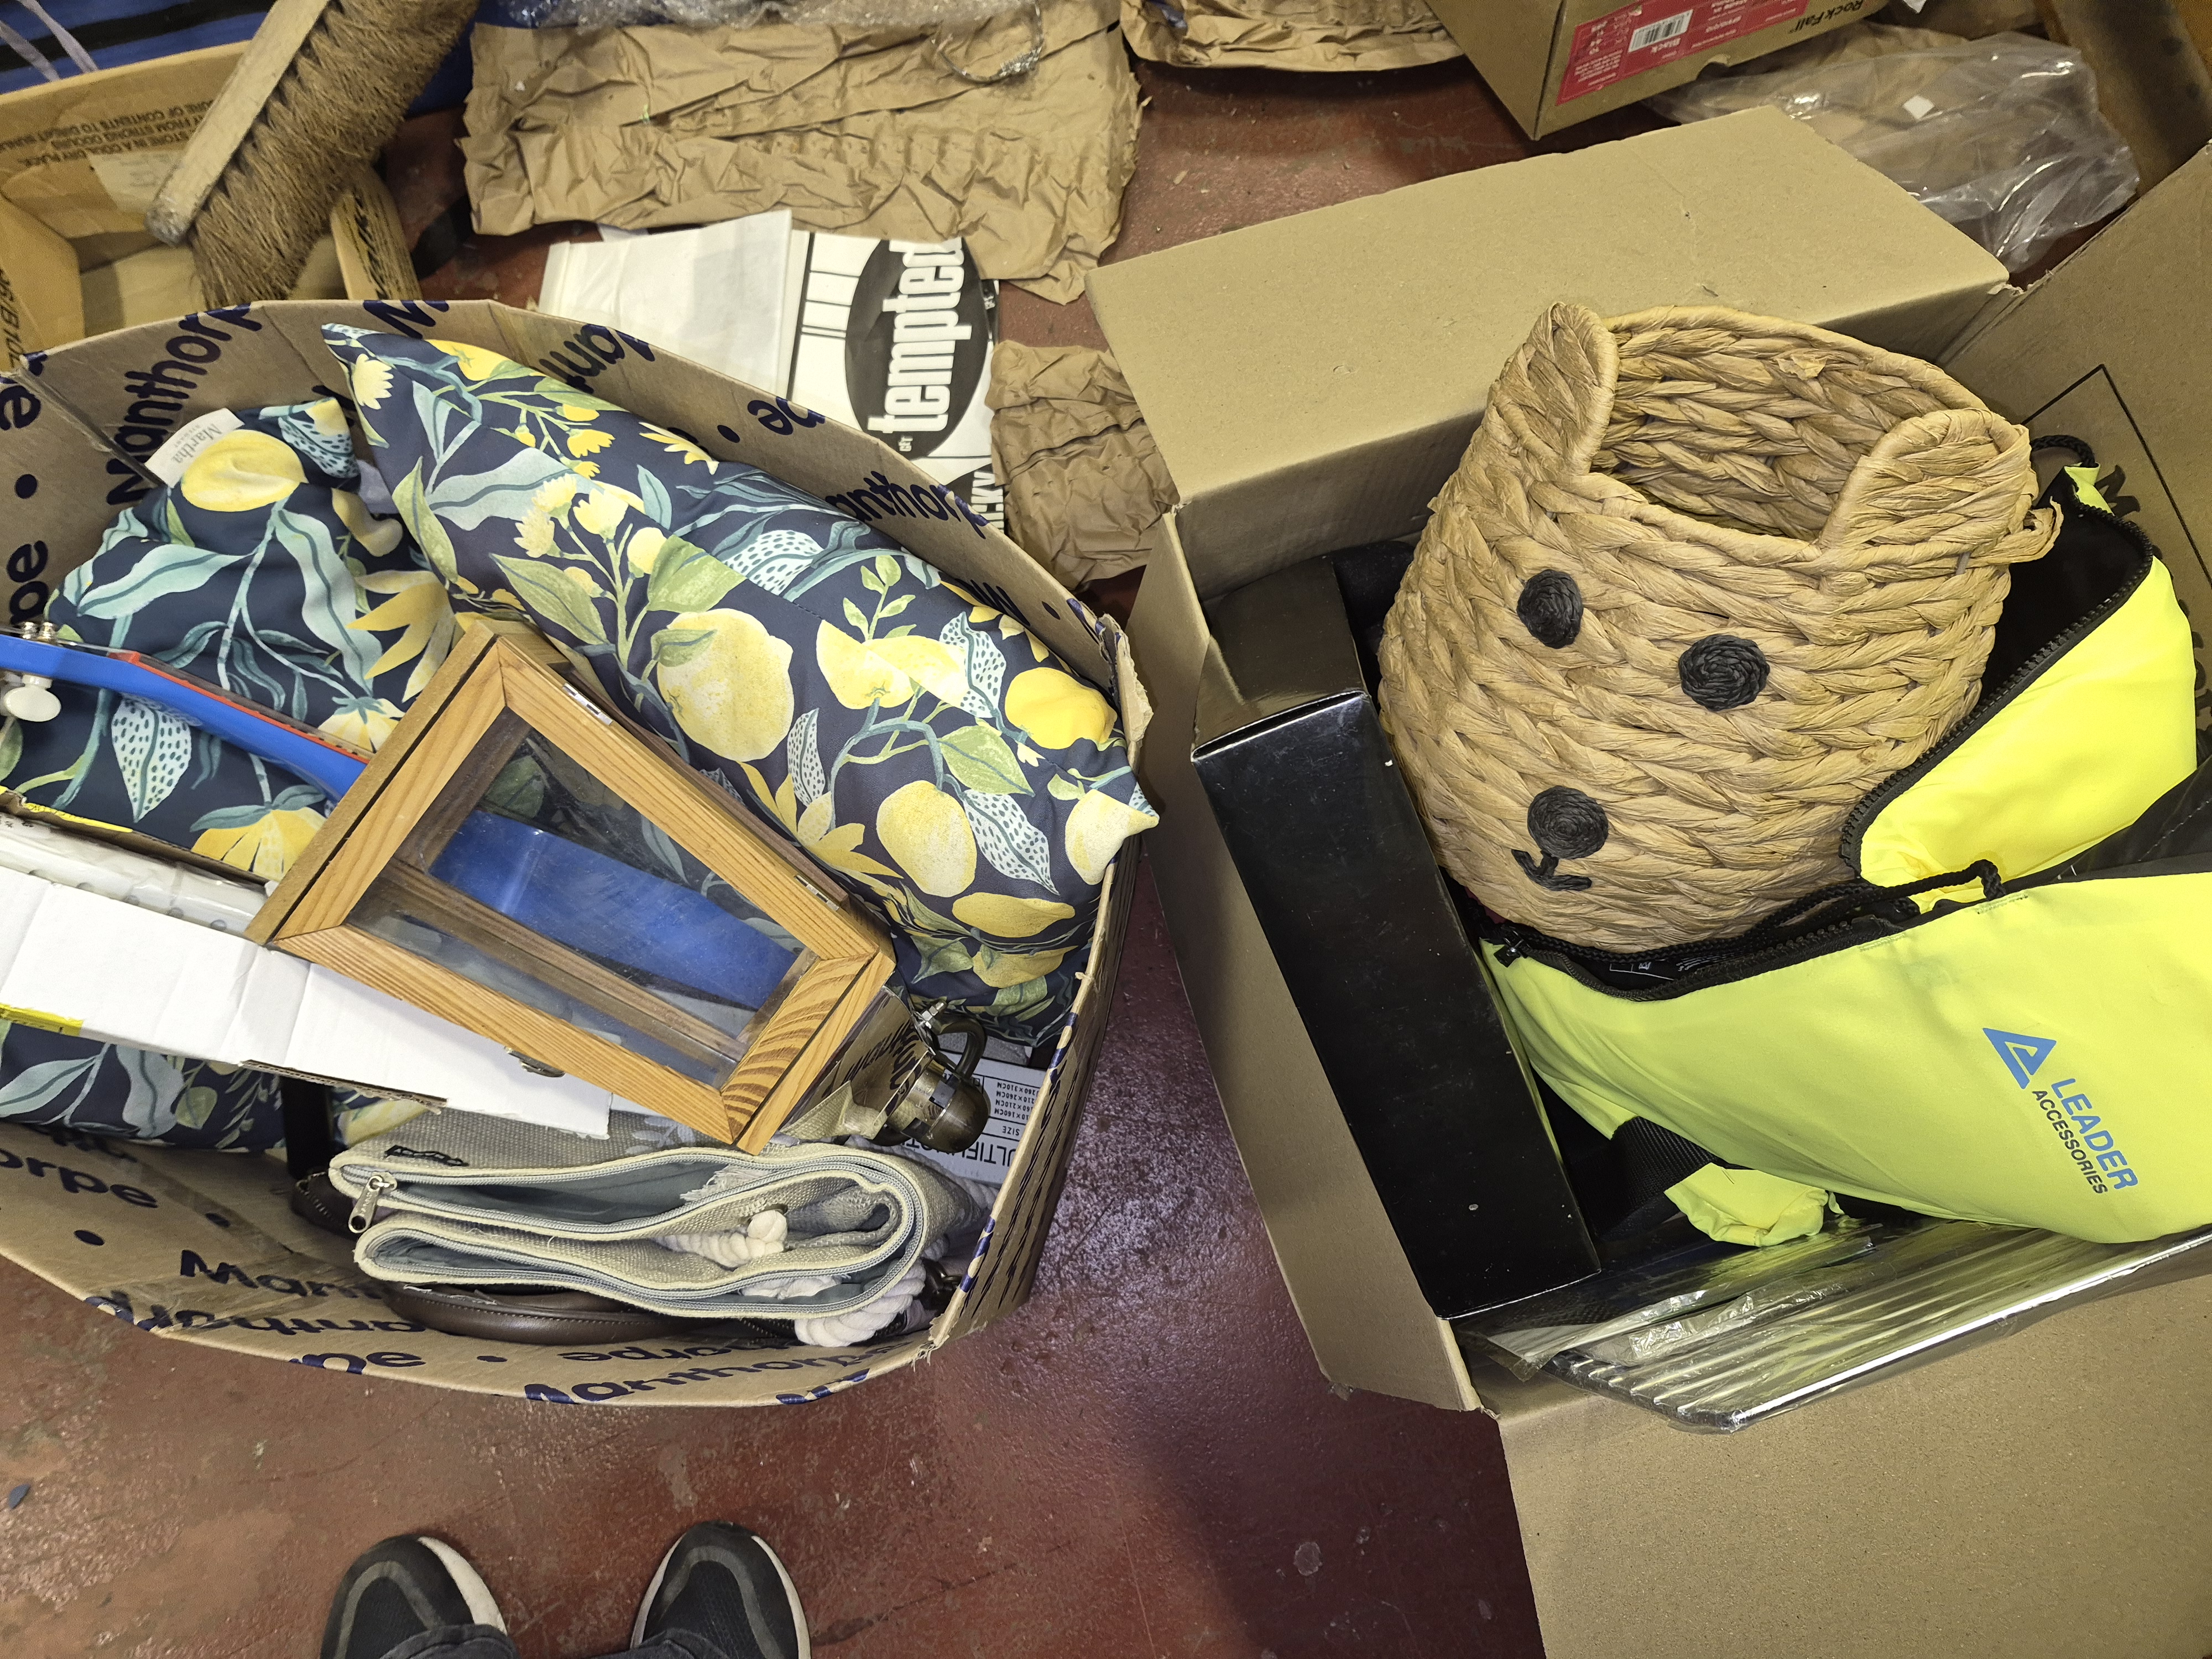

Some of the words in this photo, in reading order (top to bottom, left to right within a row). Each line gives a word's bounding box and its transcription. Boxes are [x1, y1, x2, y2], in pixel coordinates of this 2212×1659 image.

[171, 424, 222, 463] Martha
[1002, 1125, 1020, 1136] SIZE
[2032, 1090, 2108, 1194] ACCESSORIES
[2051, 1078, 2138, 1190] LEADER
